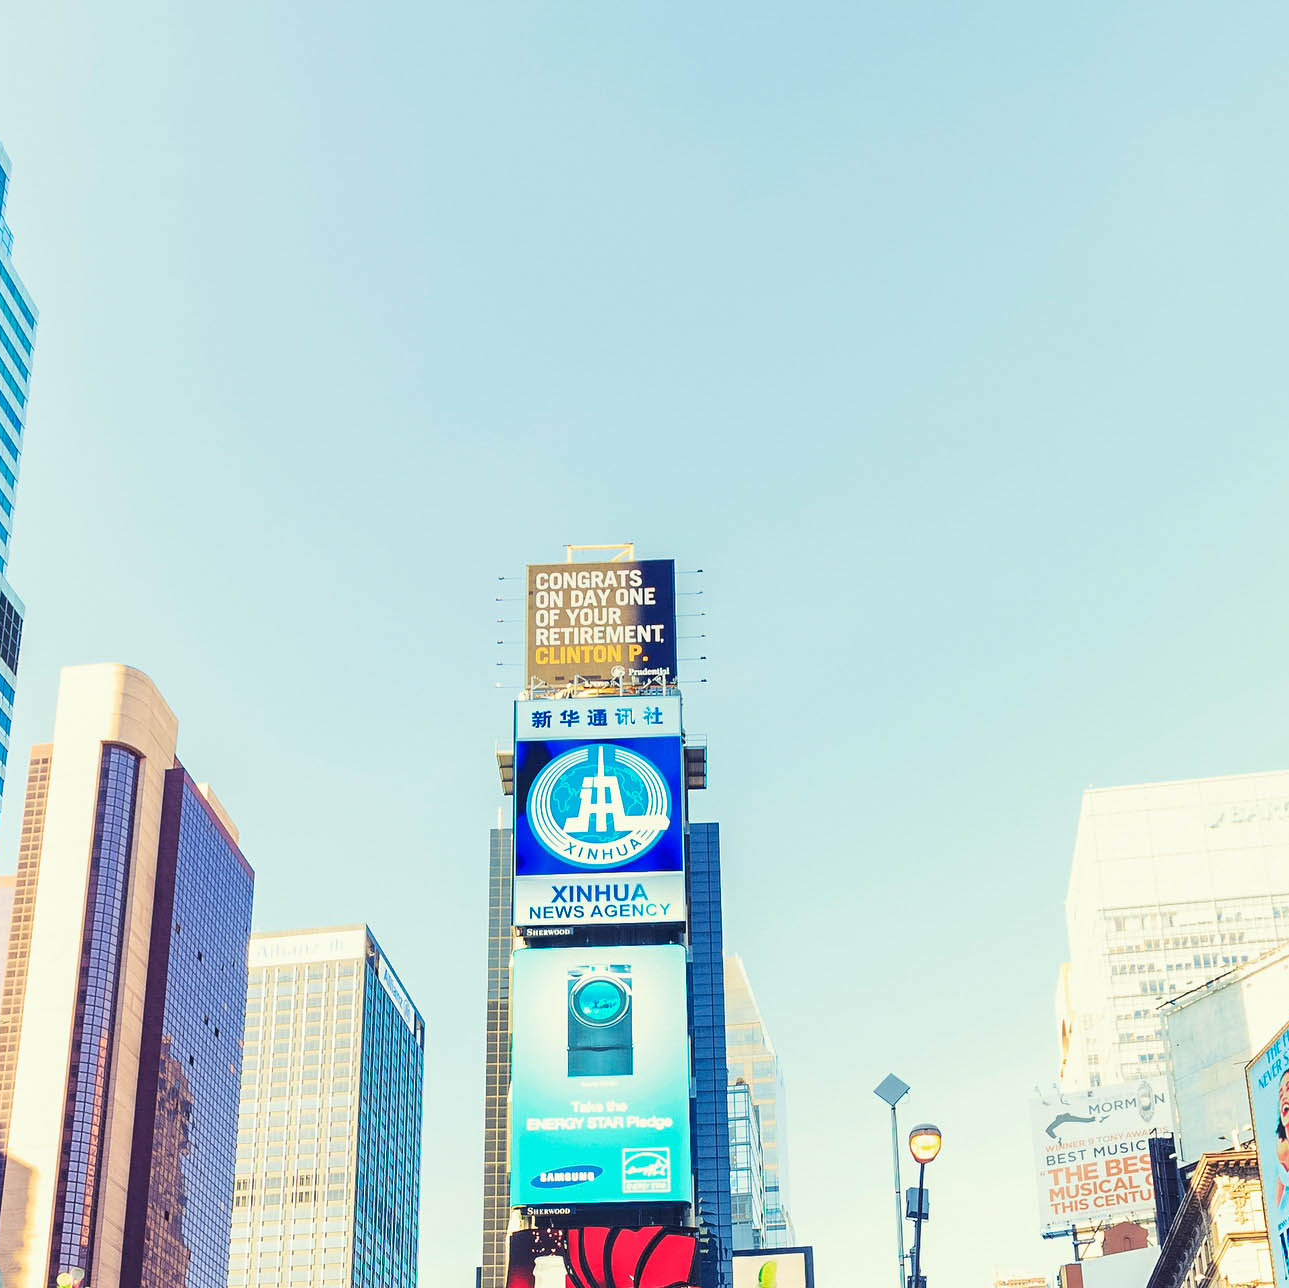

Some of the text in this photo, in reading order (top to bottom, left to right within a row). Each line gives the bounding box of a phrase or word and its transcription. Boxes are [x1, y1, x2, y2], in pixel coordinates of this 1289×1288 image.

[536, 570, 642, 590] CONGRATS
[536, 587, 656, 608] ON DAY ONE
[536, 607, 621, 627] OF YOUR
[536, 625, 664, 646] RETIREMENT,
[536, 644, 649, 665] CLINTON P.
[629, 666, 670, 676] Prudential
[532, 706, 664, 728] 新华通讯社
[564, 838, 643, 860] XINHUA
[552, 884, 648, 903] XINHUA
[529, 902, 671, 919] NEWS AGENCY
[526, 927, 570, 936] SHERWOOD
[1265, 1040, 1281, 1064] THE
[1258, 1063, 1282, 1089] NEVER
[571, 1101, 627, 1113] Take the
[526, 1116, 673, 1131] ENERGY STAR Pledge
[540, 1171, 595, 1182] SAMSUNG
[1048, 1175, 1141, 1202] MUSICAL
[527, 1207, 571, 1215] SHERWOOD
